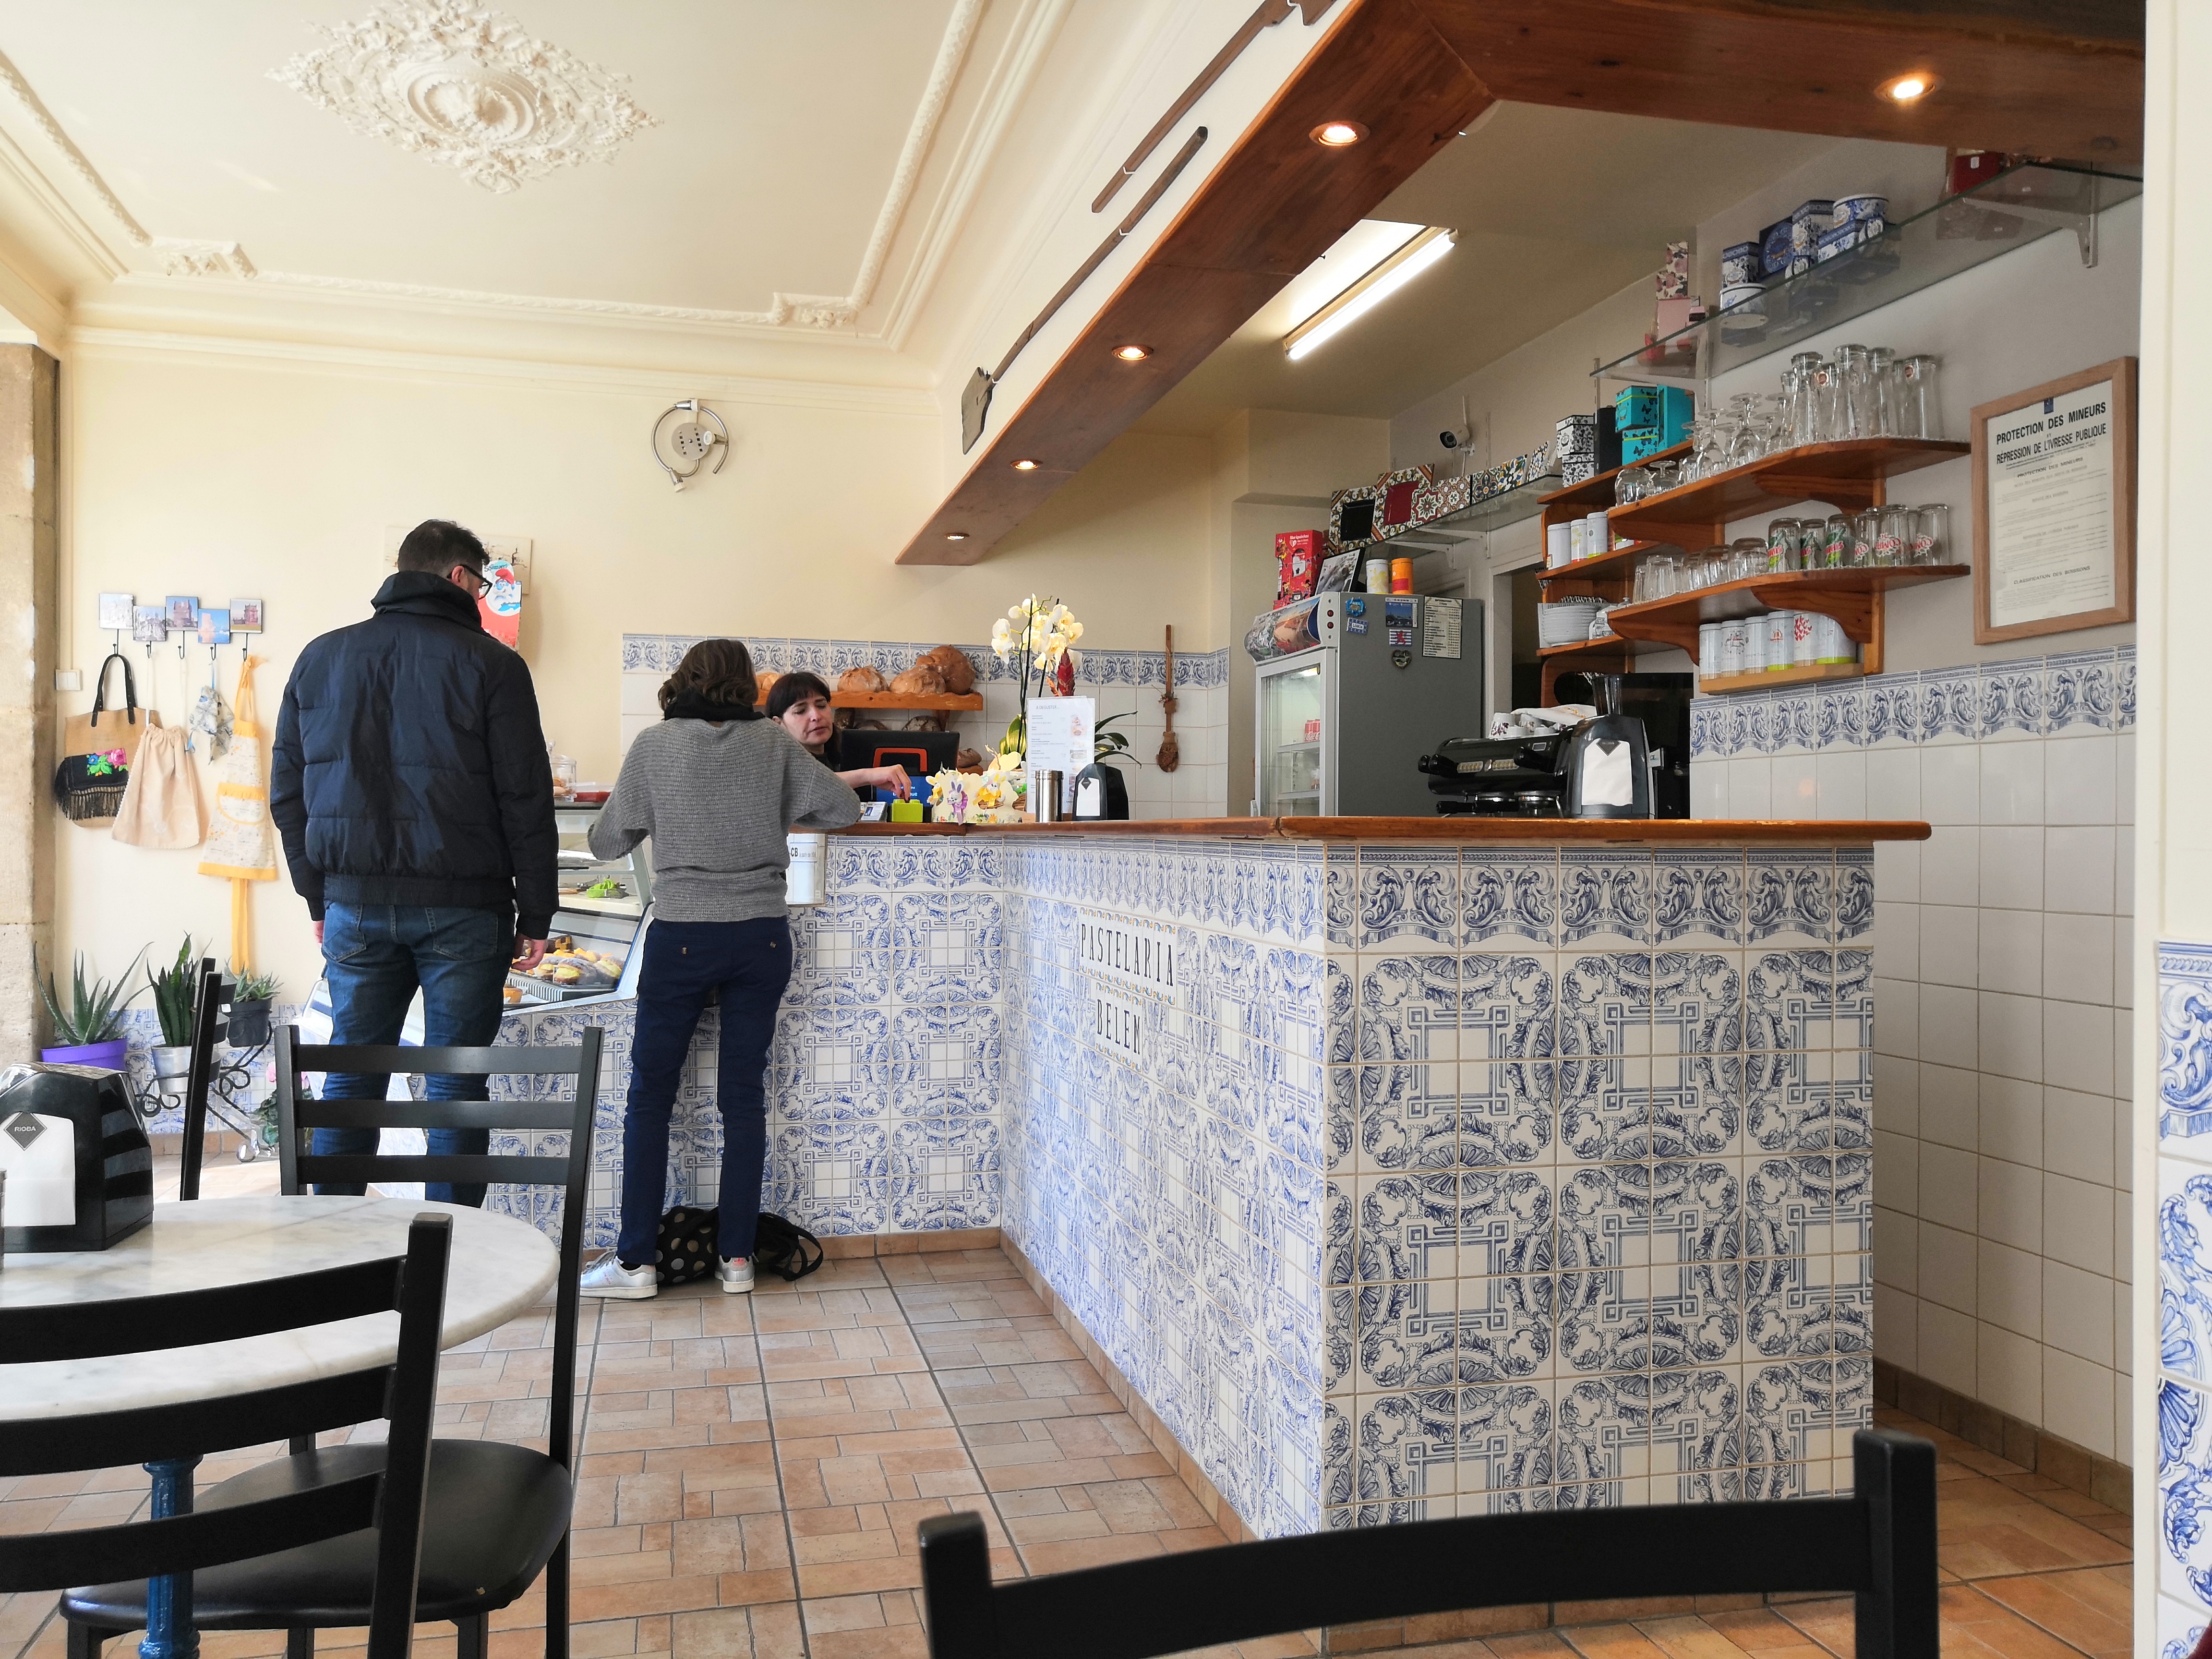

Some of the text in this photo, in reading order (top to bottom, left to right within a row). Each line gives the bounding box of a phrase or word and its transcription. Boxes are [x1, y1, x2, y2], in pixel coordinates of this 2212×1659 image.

[1996, 401, 2105, 445] PROTECTION DES MINEURS
[1996, 444, 2031, 464] RÉPRESSION
[2034, 442, 2041, 454] DE
[2044, 433, 2072, 451] L'IVRESSE
[2076, 422, 2106, 442] PUBLIQUE
[2017, 467, 2046, 479] PROTECTION
[2014, 573, 2050, 584] CLASSIFICATION
[791, 847, 798, 857] CB
[1081, 924, 1173, 986] PASTELARIA
[1097, 999, 1140, 1055] BELEM
